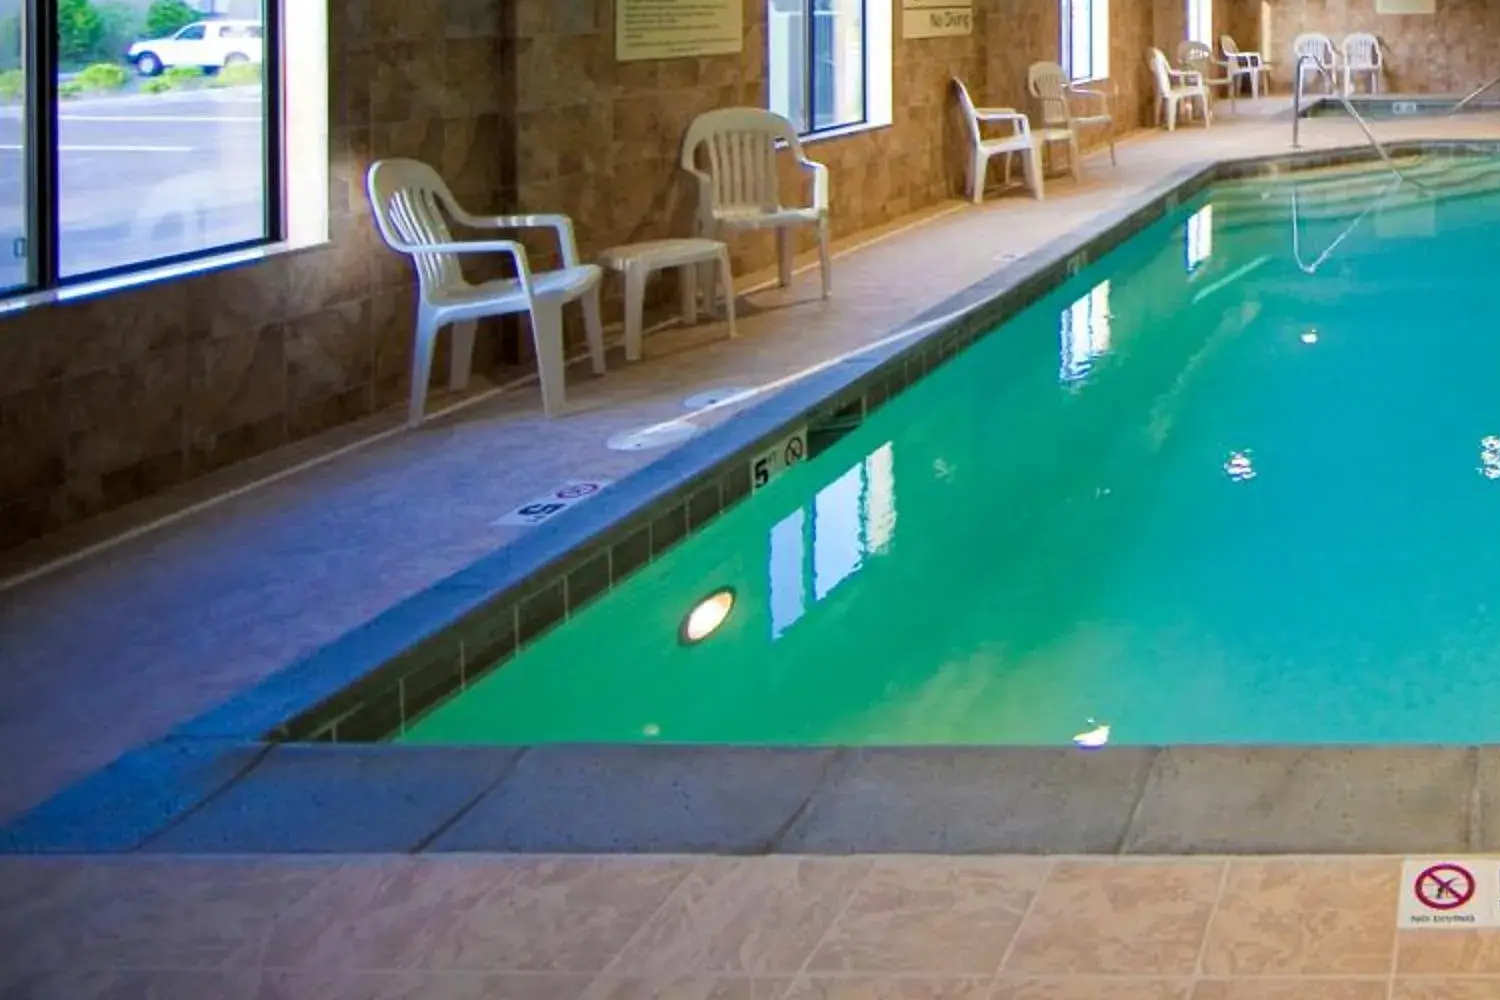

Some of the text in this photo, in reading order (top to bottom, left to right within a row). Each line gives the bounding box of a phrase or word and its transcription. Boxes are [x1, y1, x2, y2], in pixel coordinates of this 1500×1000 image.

[755, 458, 769, 489] 5
[517, 503, 566, 515] 5
[1410, 914, 1476, 924] NO DIVING
